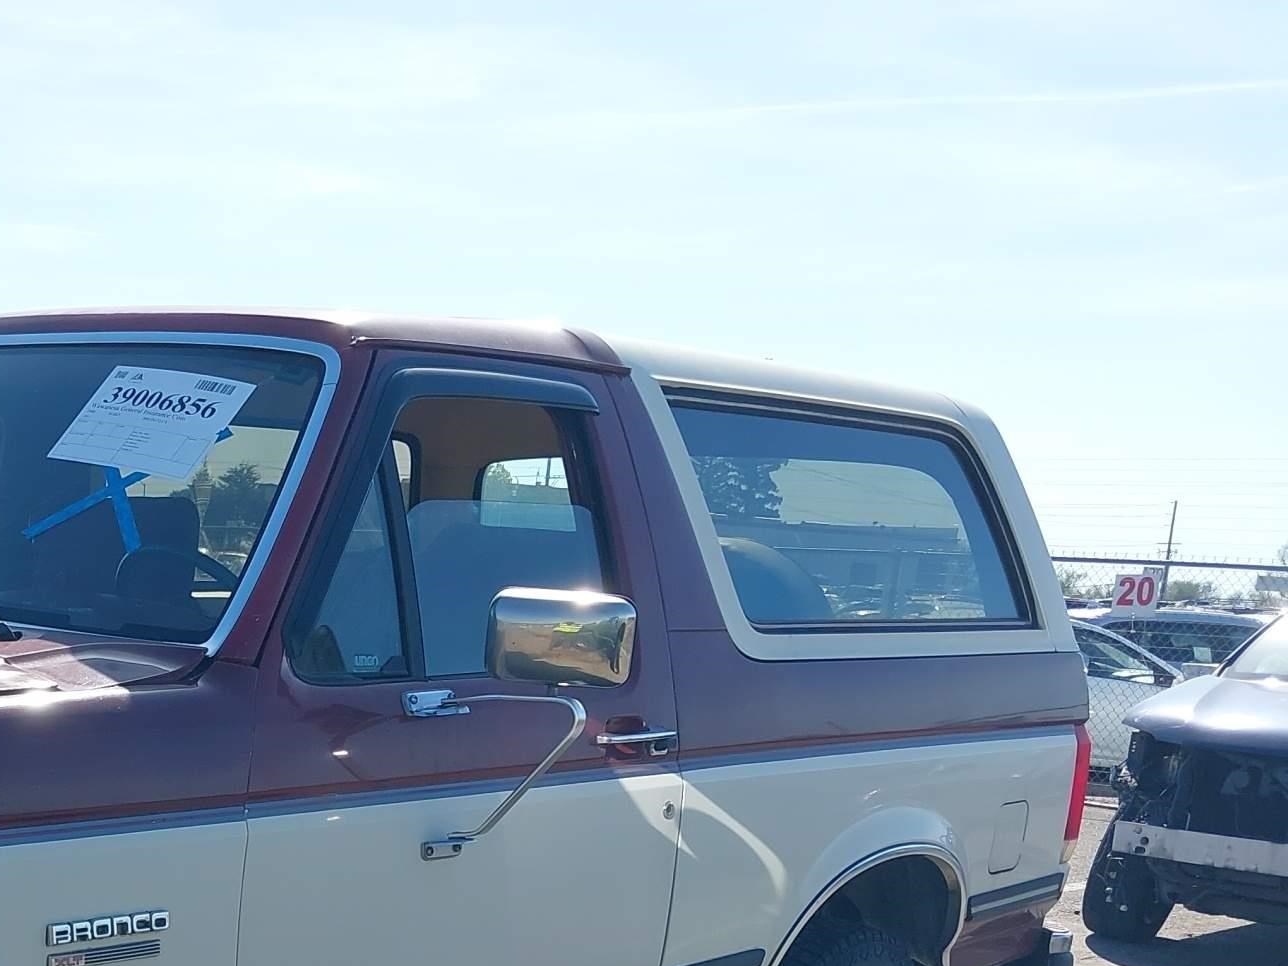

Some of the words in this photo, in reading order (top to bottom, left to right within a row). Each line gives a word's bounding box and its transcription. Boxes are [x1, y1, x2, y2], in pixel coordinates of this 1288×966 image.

[103, 386, 224, 419] 39006856
[1116, 576, 1155, 606] 20
[51, 911, 169, 945] BRONCO
